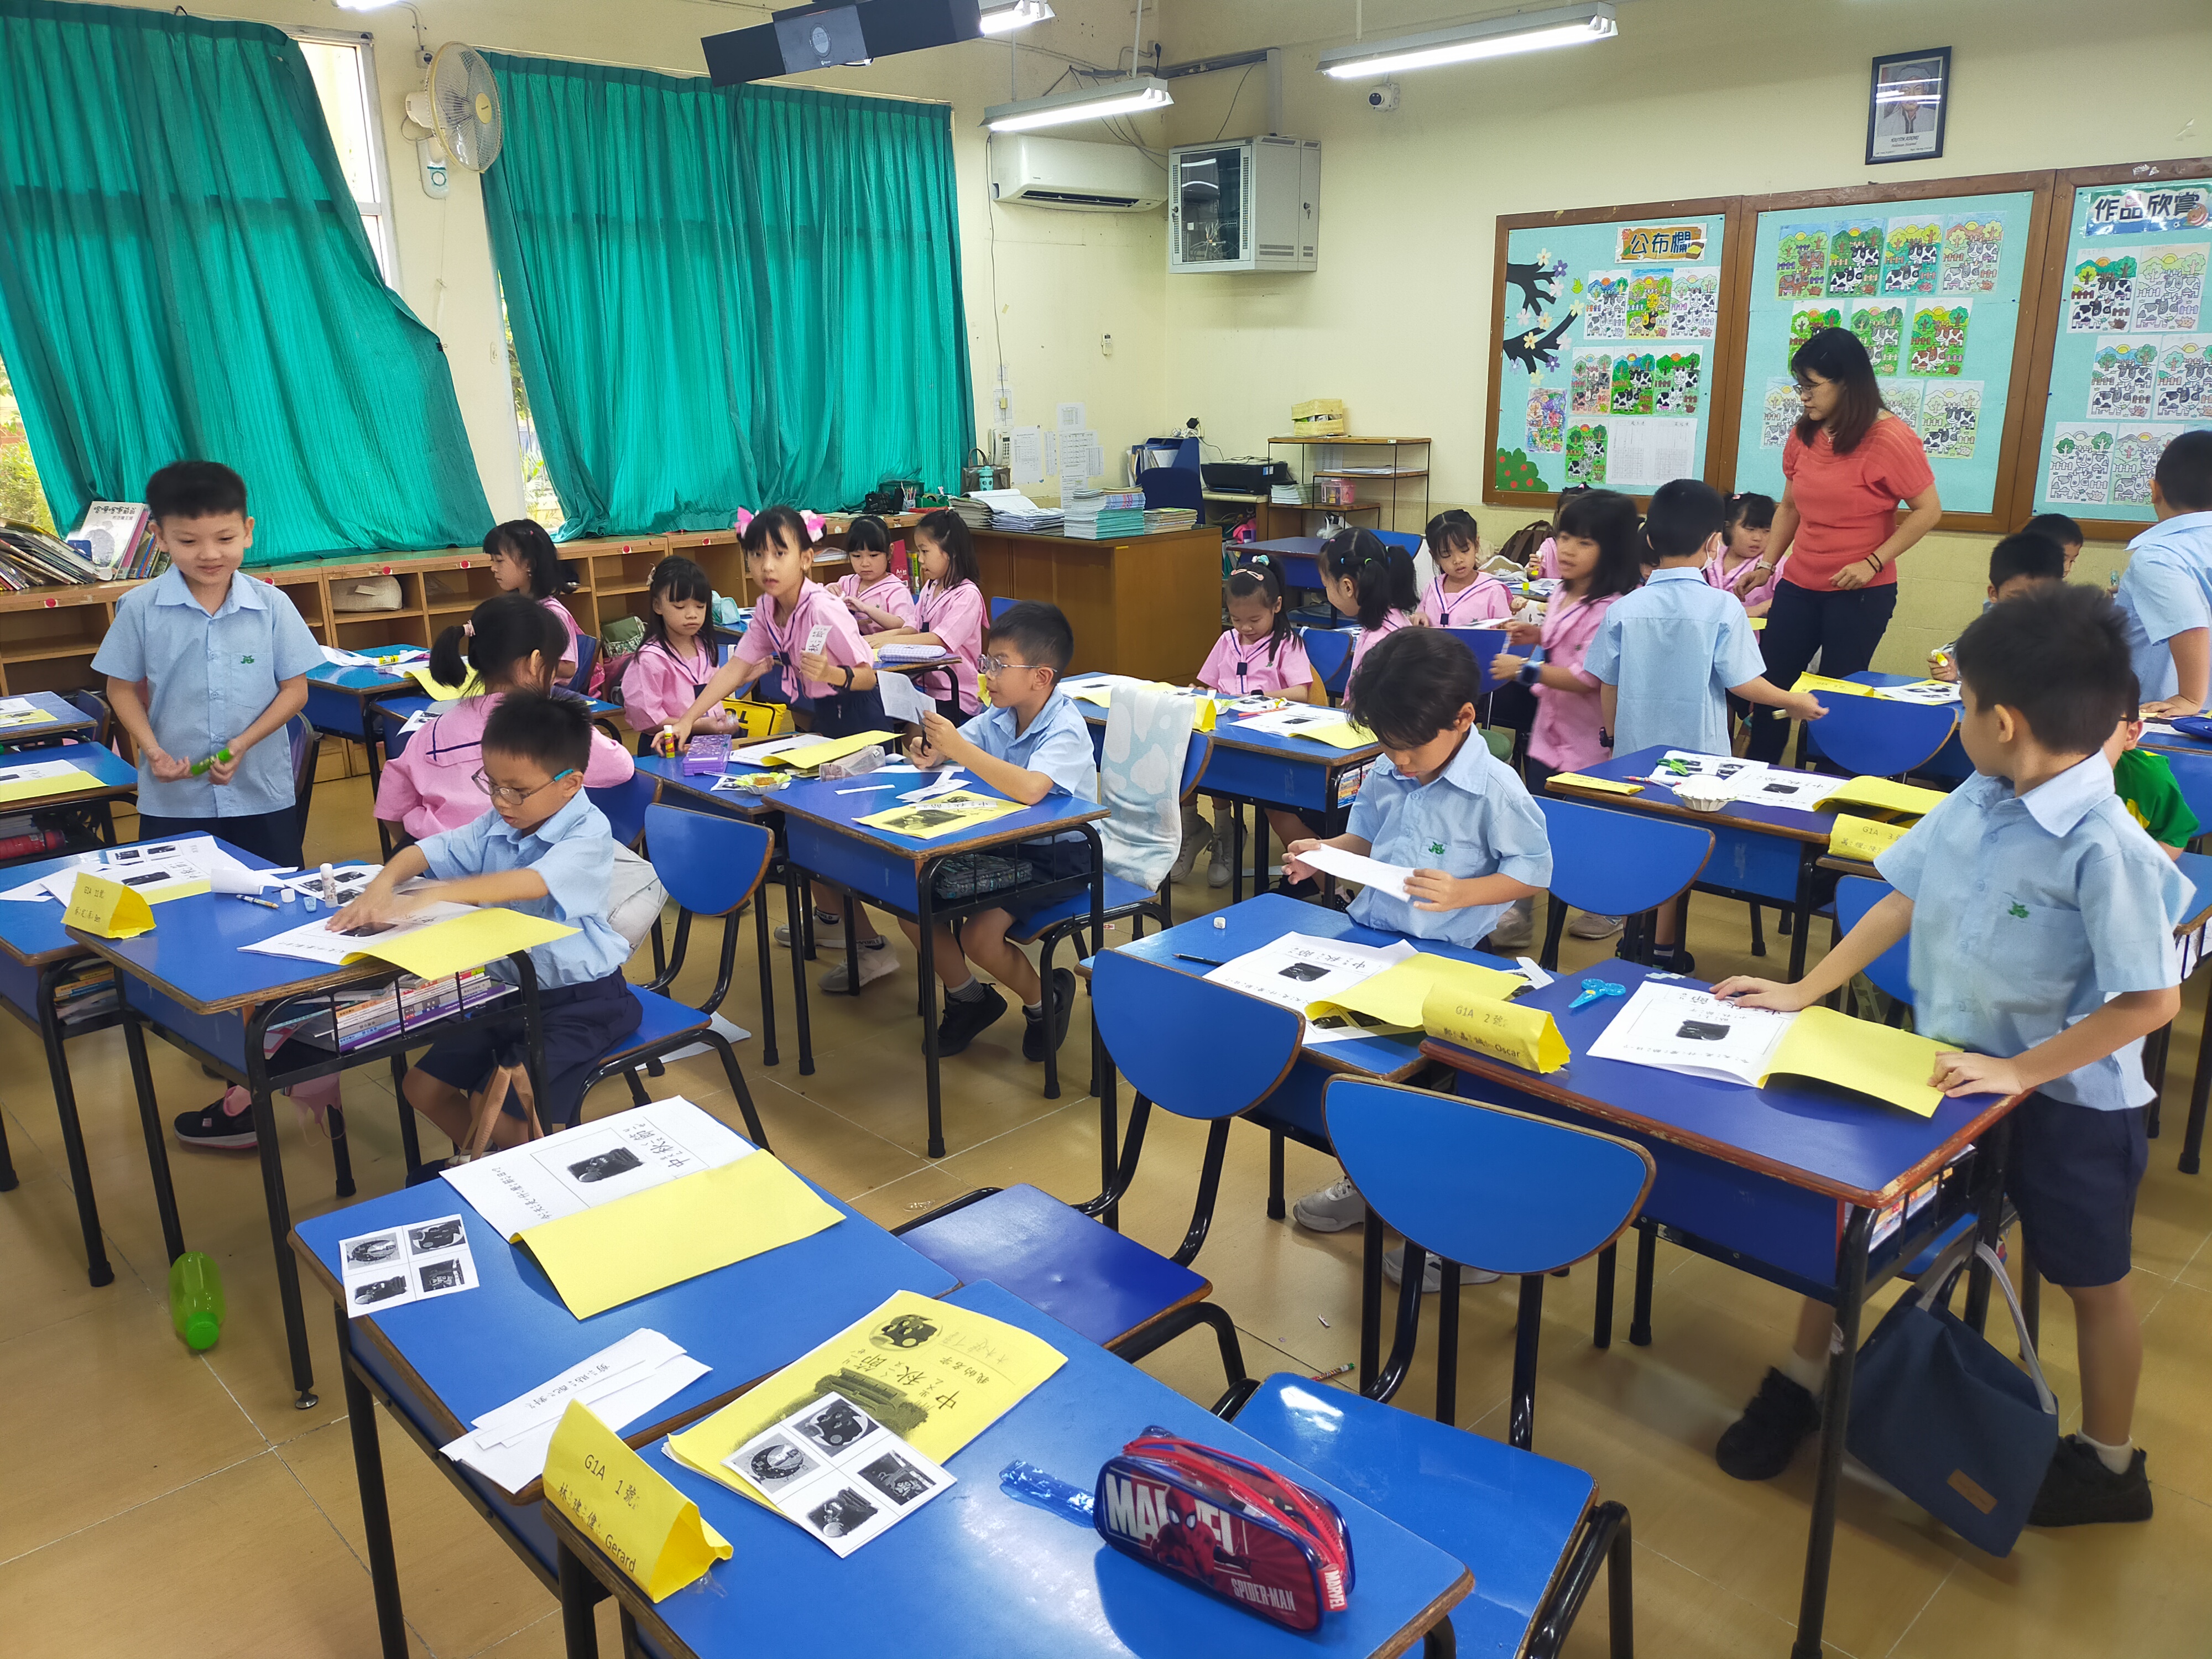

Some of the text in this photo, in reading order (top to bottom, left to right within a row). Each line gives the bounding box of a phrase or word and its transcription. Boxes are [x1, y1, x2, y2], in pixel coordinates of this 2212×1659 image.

[2095, 192, 2200, 222] 作品欣賞
[1630, 231, 1691, 254] 公布欄
[1863, 826, 1879, 836] G1A
[1287, 946, 1367, 969] 中秋節
[1455, 1005, 1474, 1018] G1A
[1495, 1044, 1520, 1058] Oscar
[623, 1122, 691, 1170] 中秋節
[847, 1350, 958, 1410] 中秋節
[938, 1355, 990, 1384] 我的名字
[585, 1454, 605, 1480] G1A
[605, 1534, 637, 1573] Gerard
[1231, 1578, 1296, 1612] SPIDER-MAN
[1324, 1571, 1346, 1610] MARVEL
